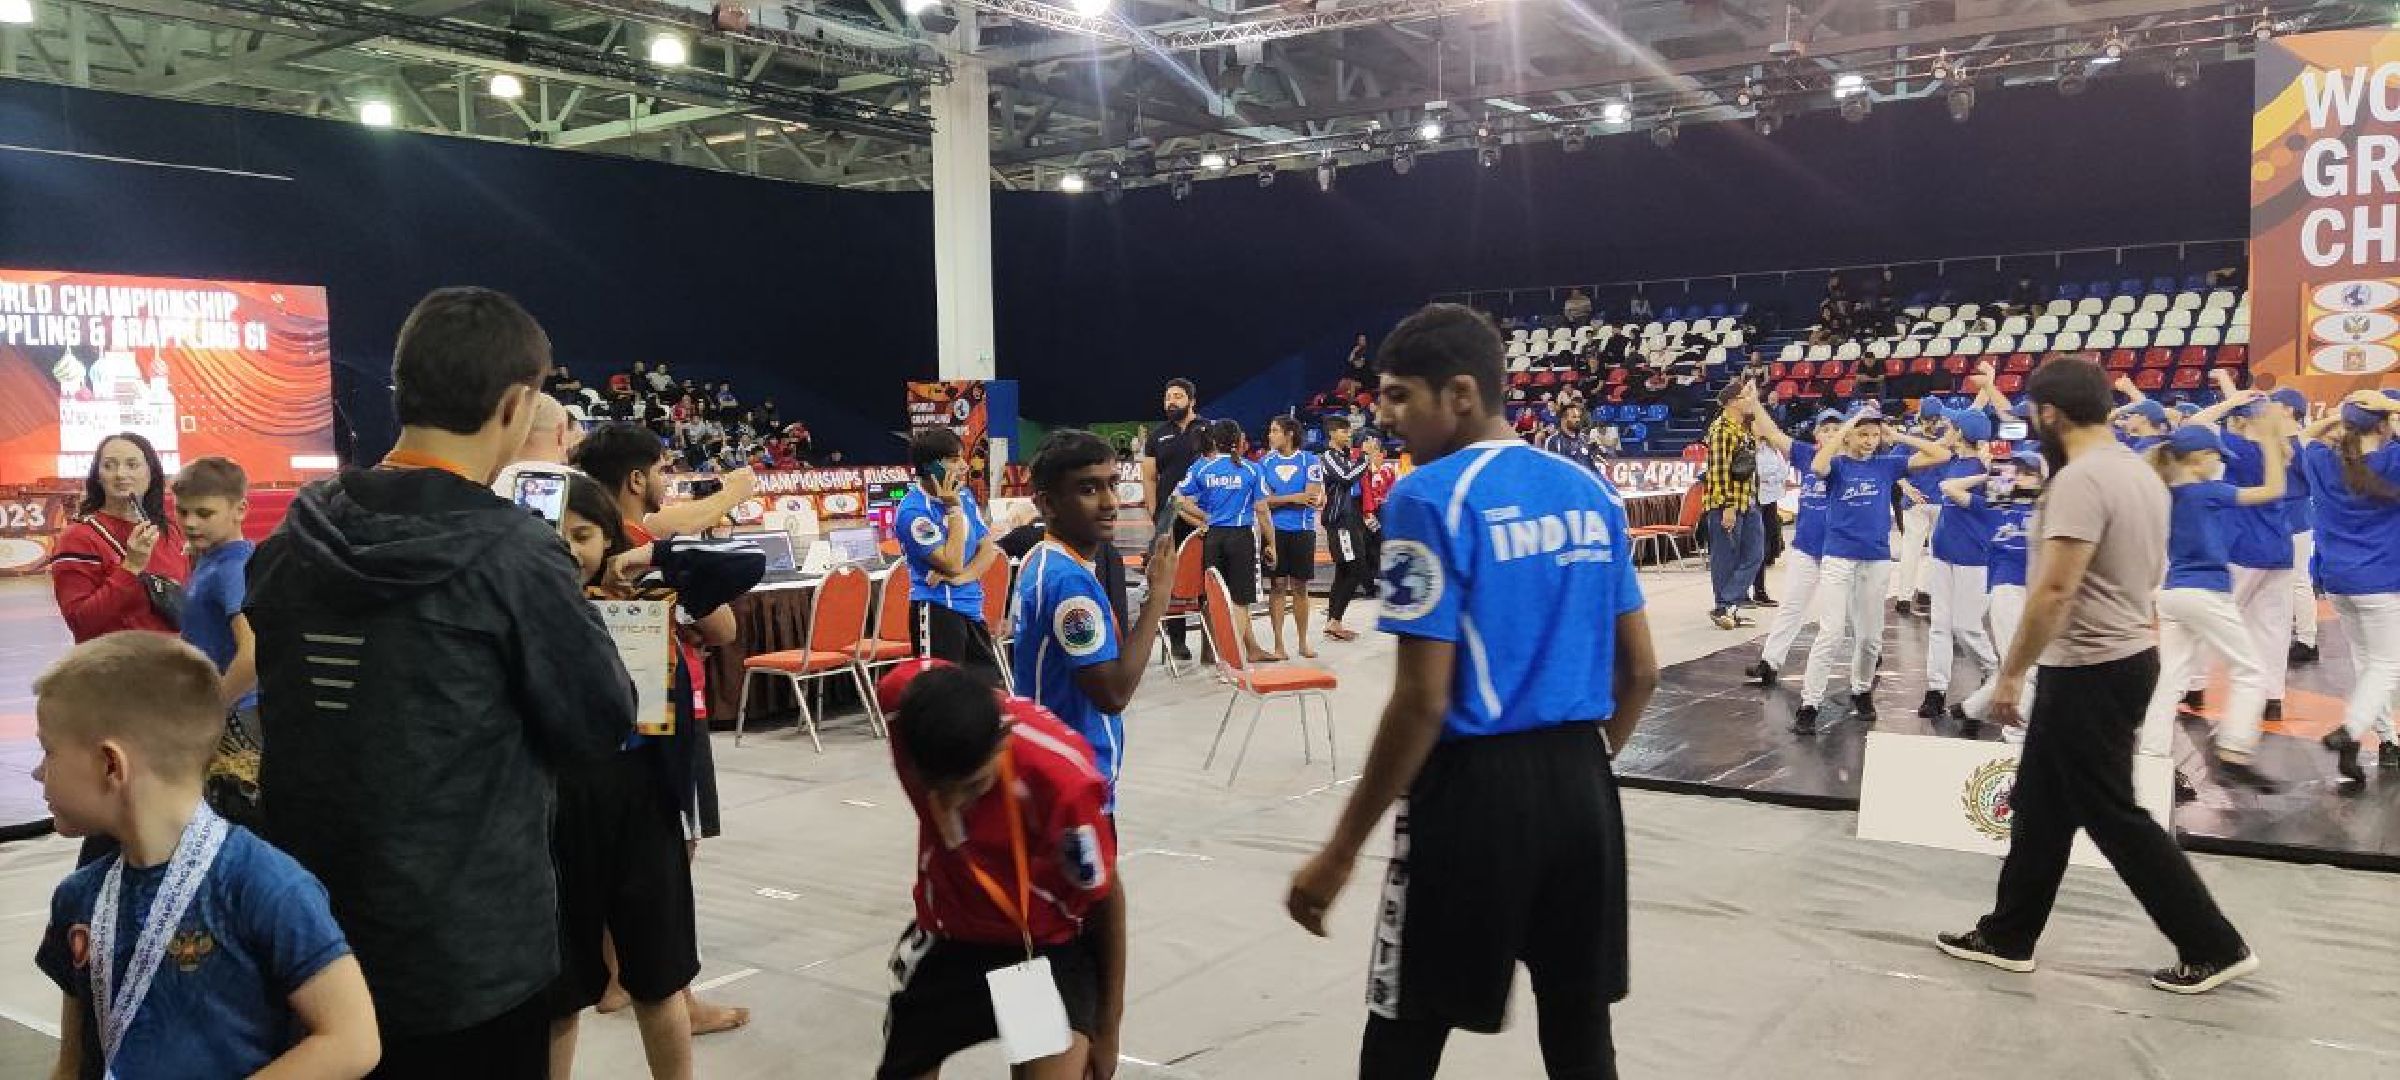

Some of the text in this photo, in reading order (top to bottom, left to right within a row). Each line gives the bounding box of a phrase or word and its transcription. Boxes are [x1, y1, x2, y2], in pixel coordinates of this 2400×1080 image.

[2302, 61, 2400, 128] WO
[2302, 134, 2400, 197] GR
[2301, 202, 2398, 267] CH
[0, 282, 239, 321] RLD CHAMPIONSHIP
[112, 317, 241, 349] GRAPPLING
[1488, 509, 1611, 562] INDIA
